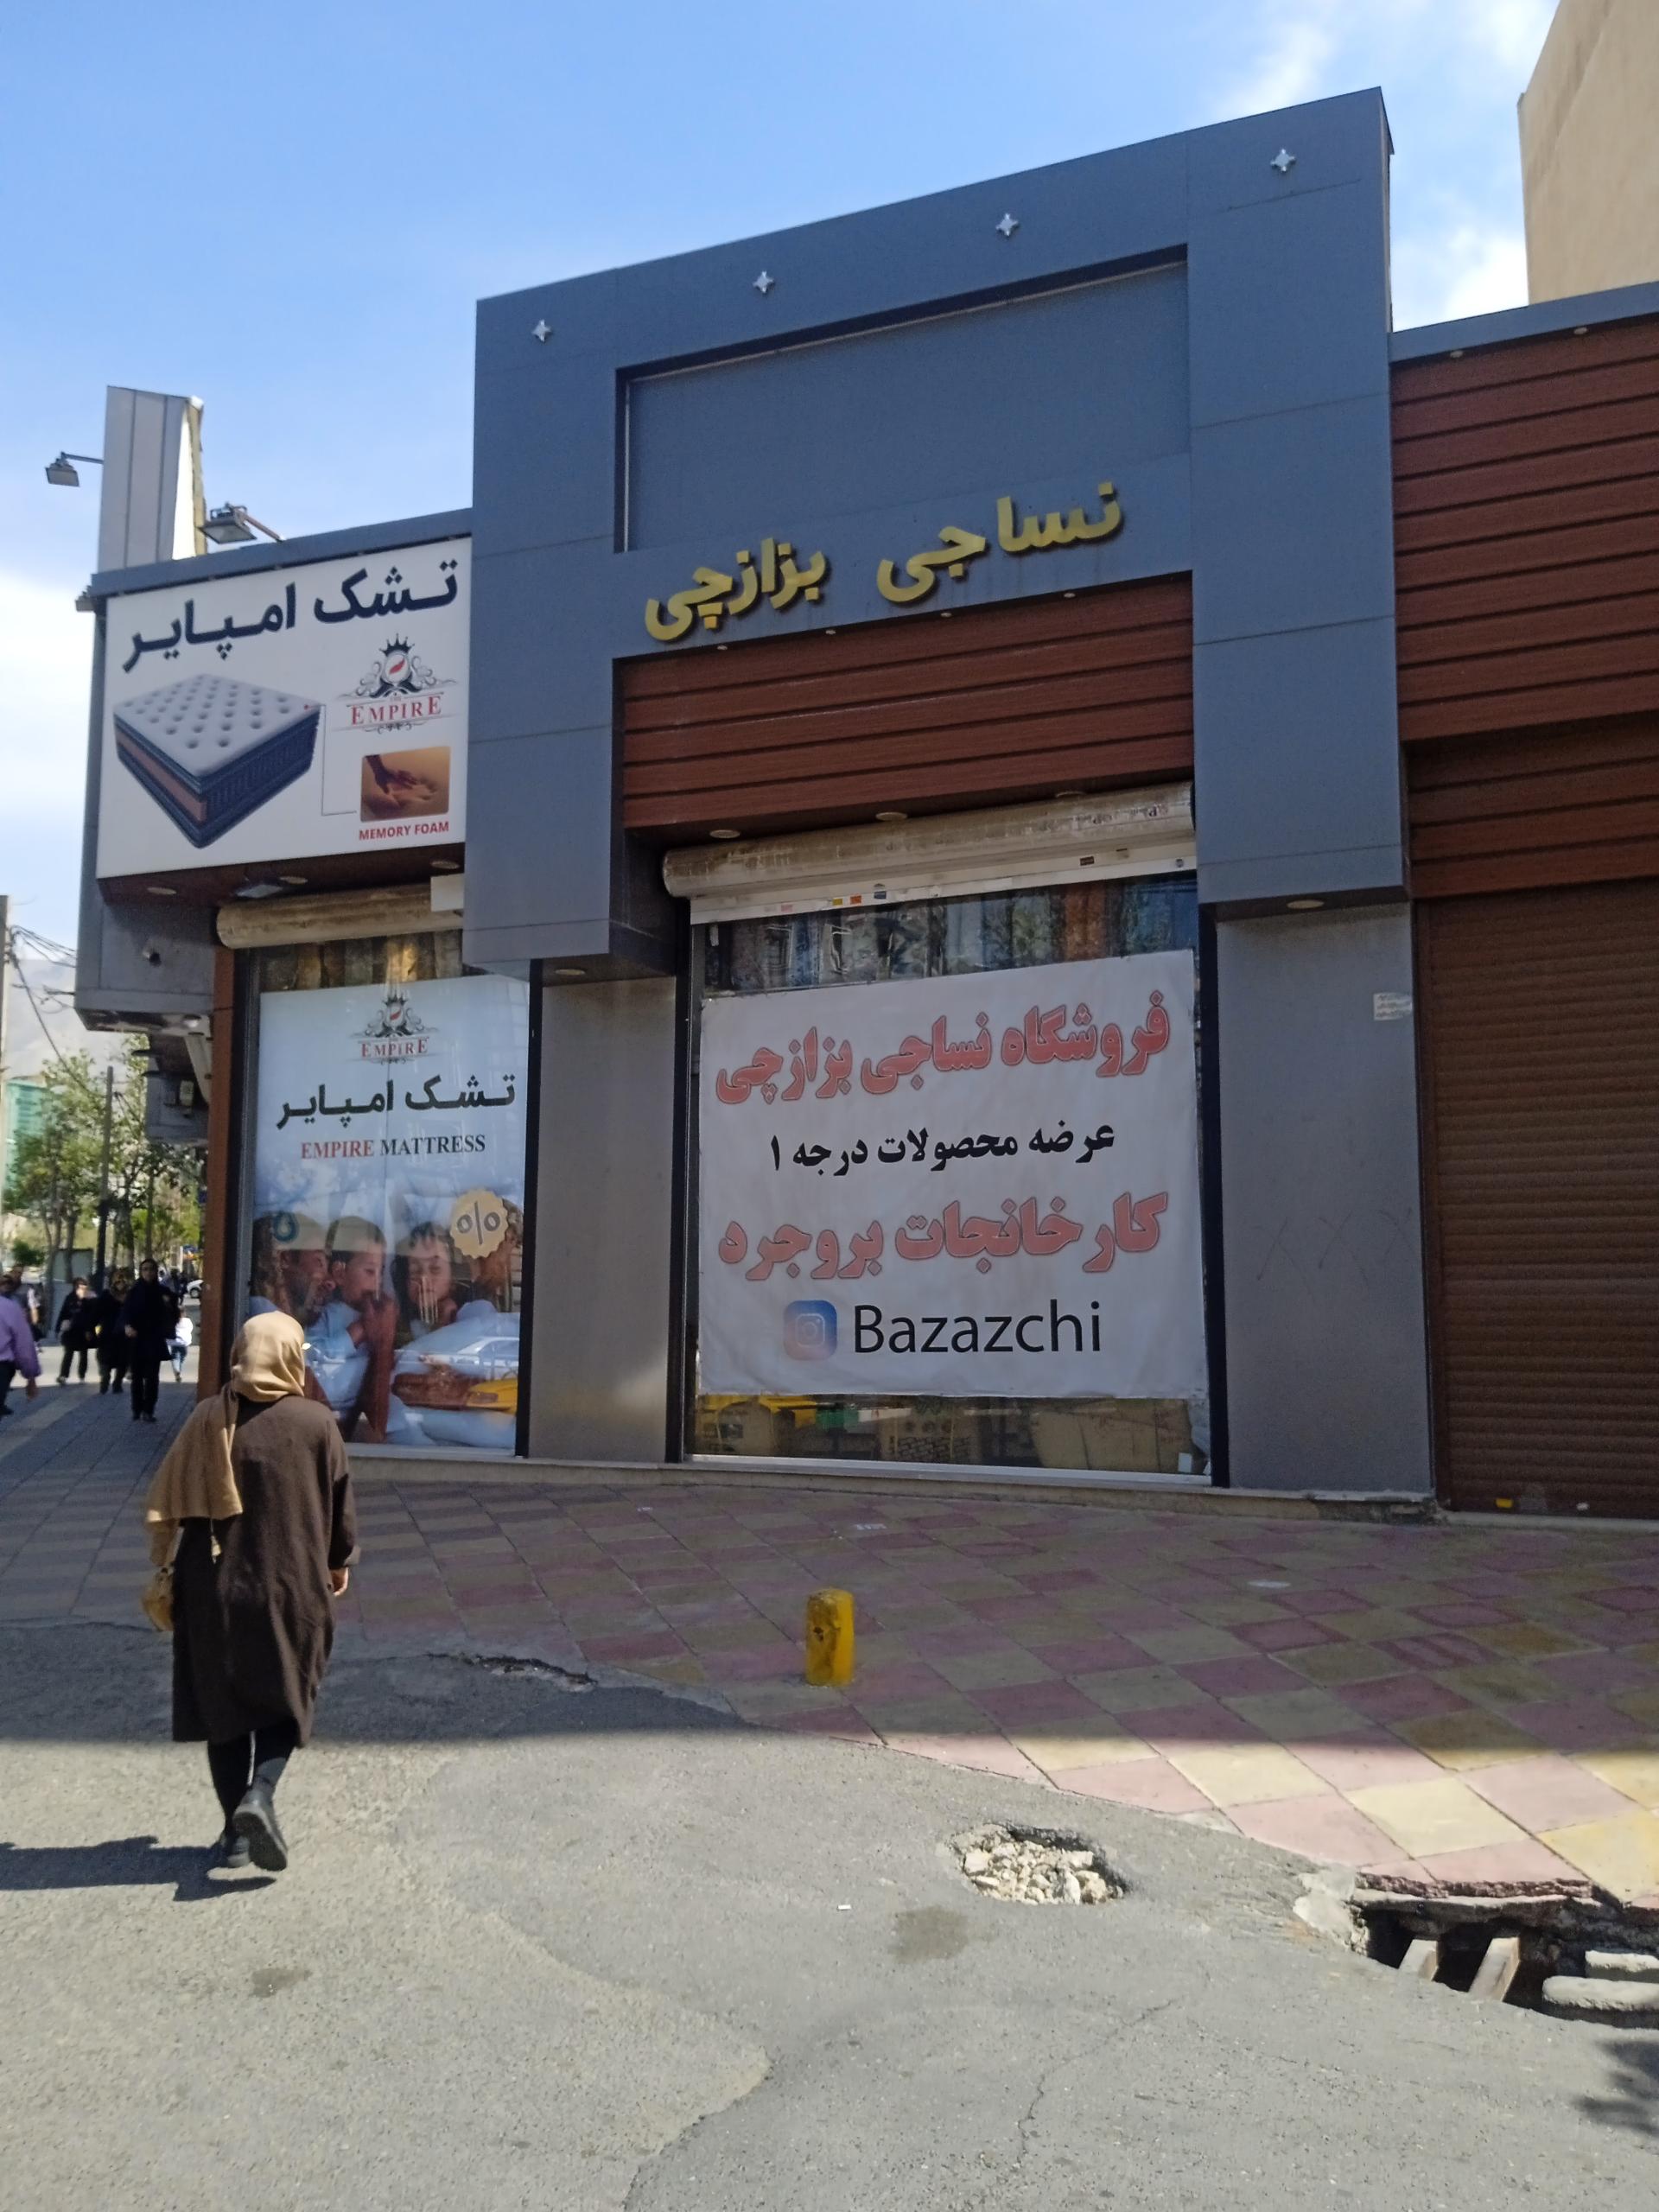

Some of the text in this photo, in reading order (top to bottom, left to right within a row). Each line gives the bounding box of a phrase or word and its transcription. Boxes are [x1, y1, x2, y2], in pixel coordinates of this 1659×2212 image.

[645, 537, 828, 642] بزازچی
[122, 559, 459, 673] تشک امپایر
[351, 695, 442, 726] EMPIRE
[359, 821, 449, 841] MEMORY FOAM
[361, 1037, 429, 1059] EMPIRE
[715, 990, 1171, 1105] فروشگاه نساجی بزازچی
[276, 1074, 516, 1130] تشک امپایر
[301, 1134, 486, 1160] EMPIRE MATTRESS
[792, 1139, 868, 1177] درجه
[877, 1128, 1018, 1172] محصولات
[1027, 1120, 1116, 1164] عرضه
[894, 1192, 1168, 1274] کارخانجات
[855, 1299, 1101, 1353] Bazazchi
